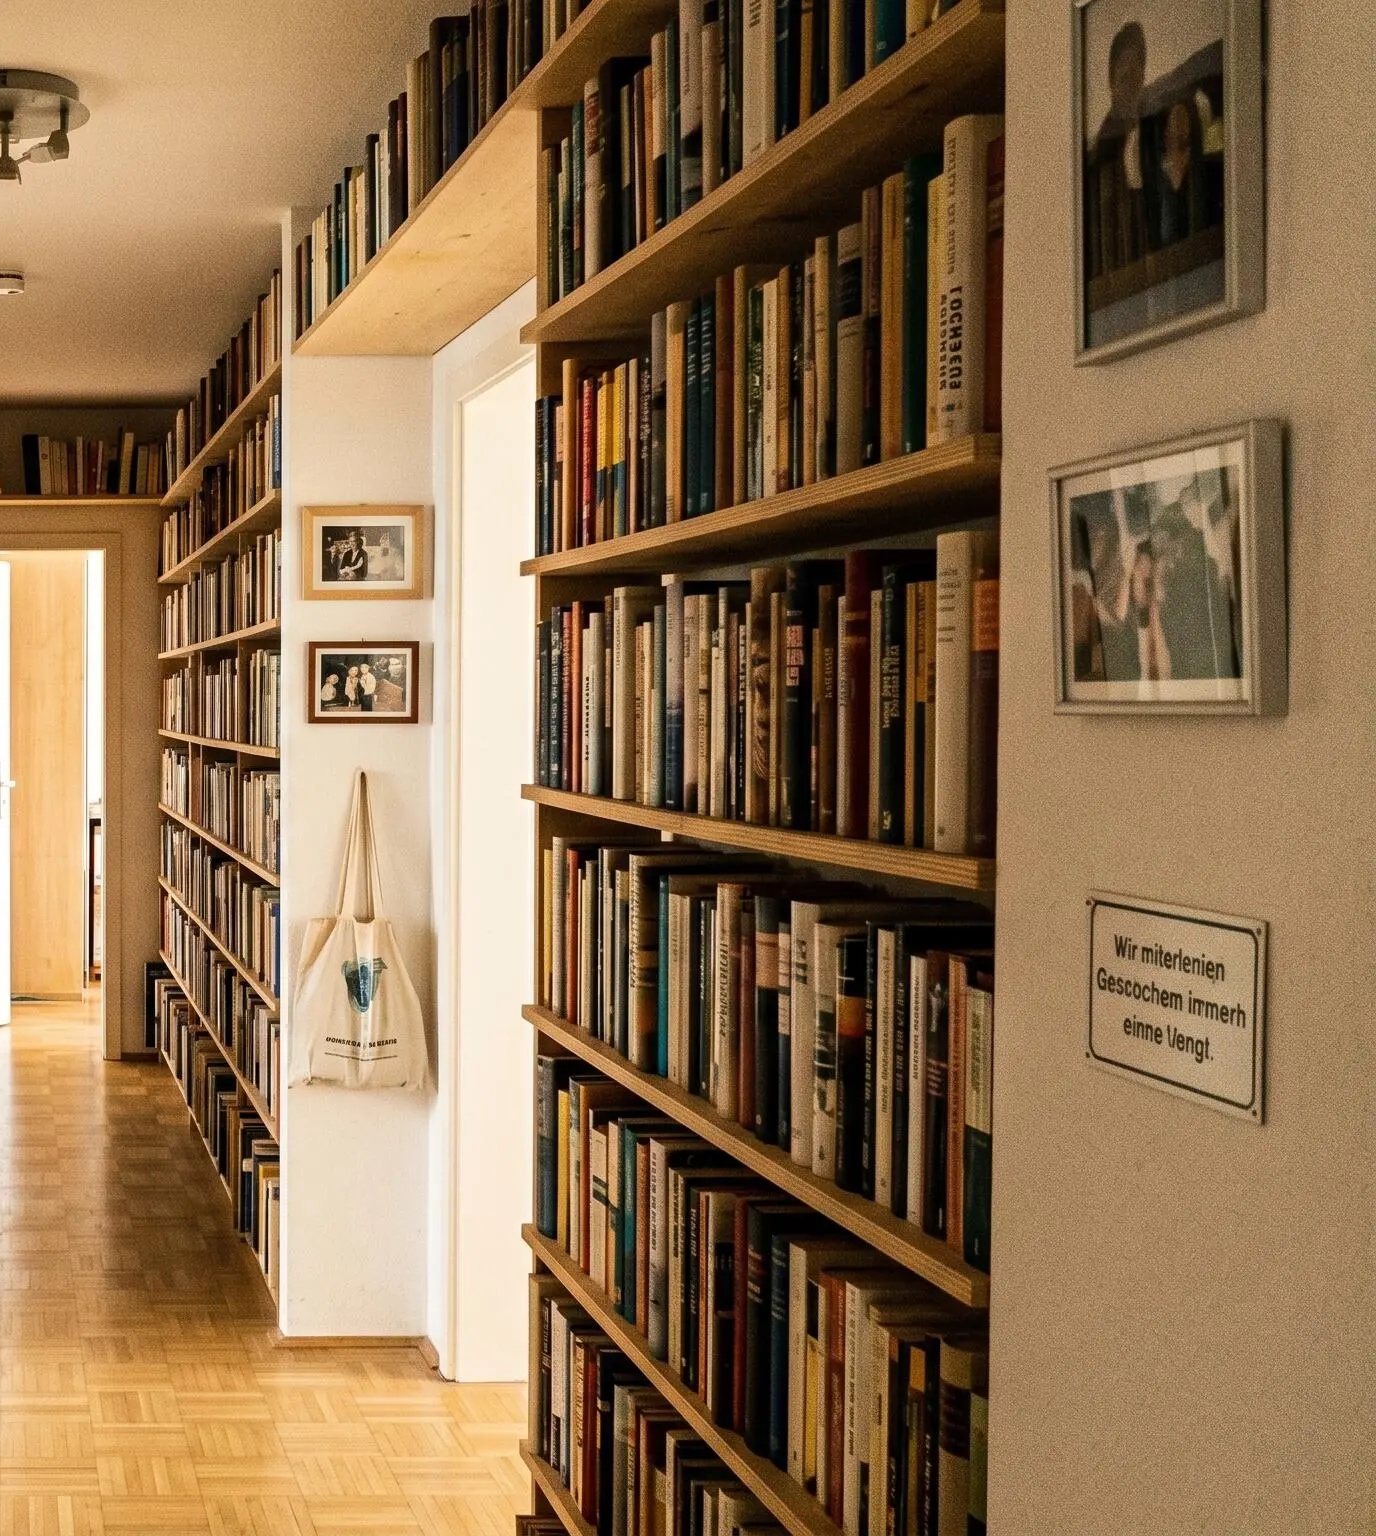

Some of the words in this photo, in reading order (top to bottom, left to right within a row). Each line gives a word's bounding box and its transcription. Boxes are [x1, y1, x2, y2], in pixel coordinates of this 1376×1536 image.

[1114, 934, 1138, 961] Wir
[1096, 966, 1183, 1011] Gescochem
[1123, 1014, 1163, 1045] einne
